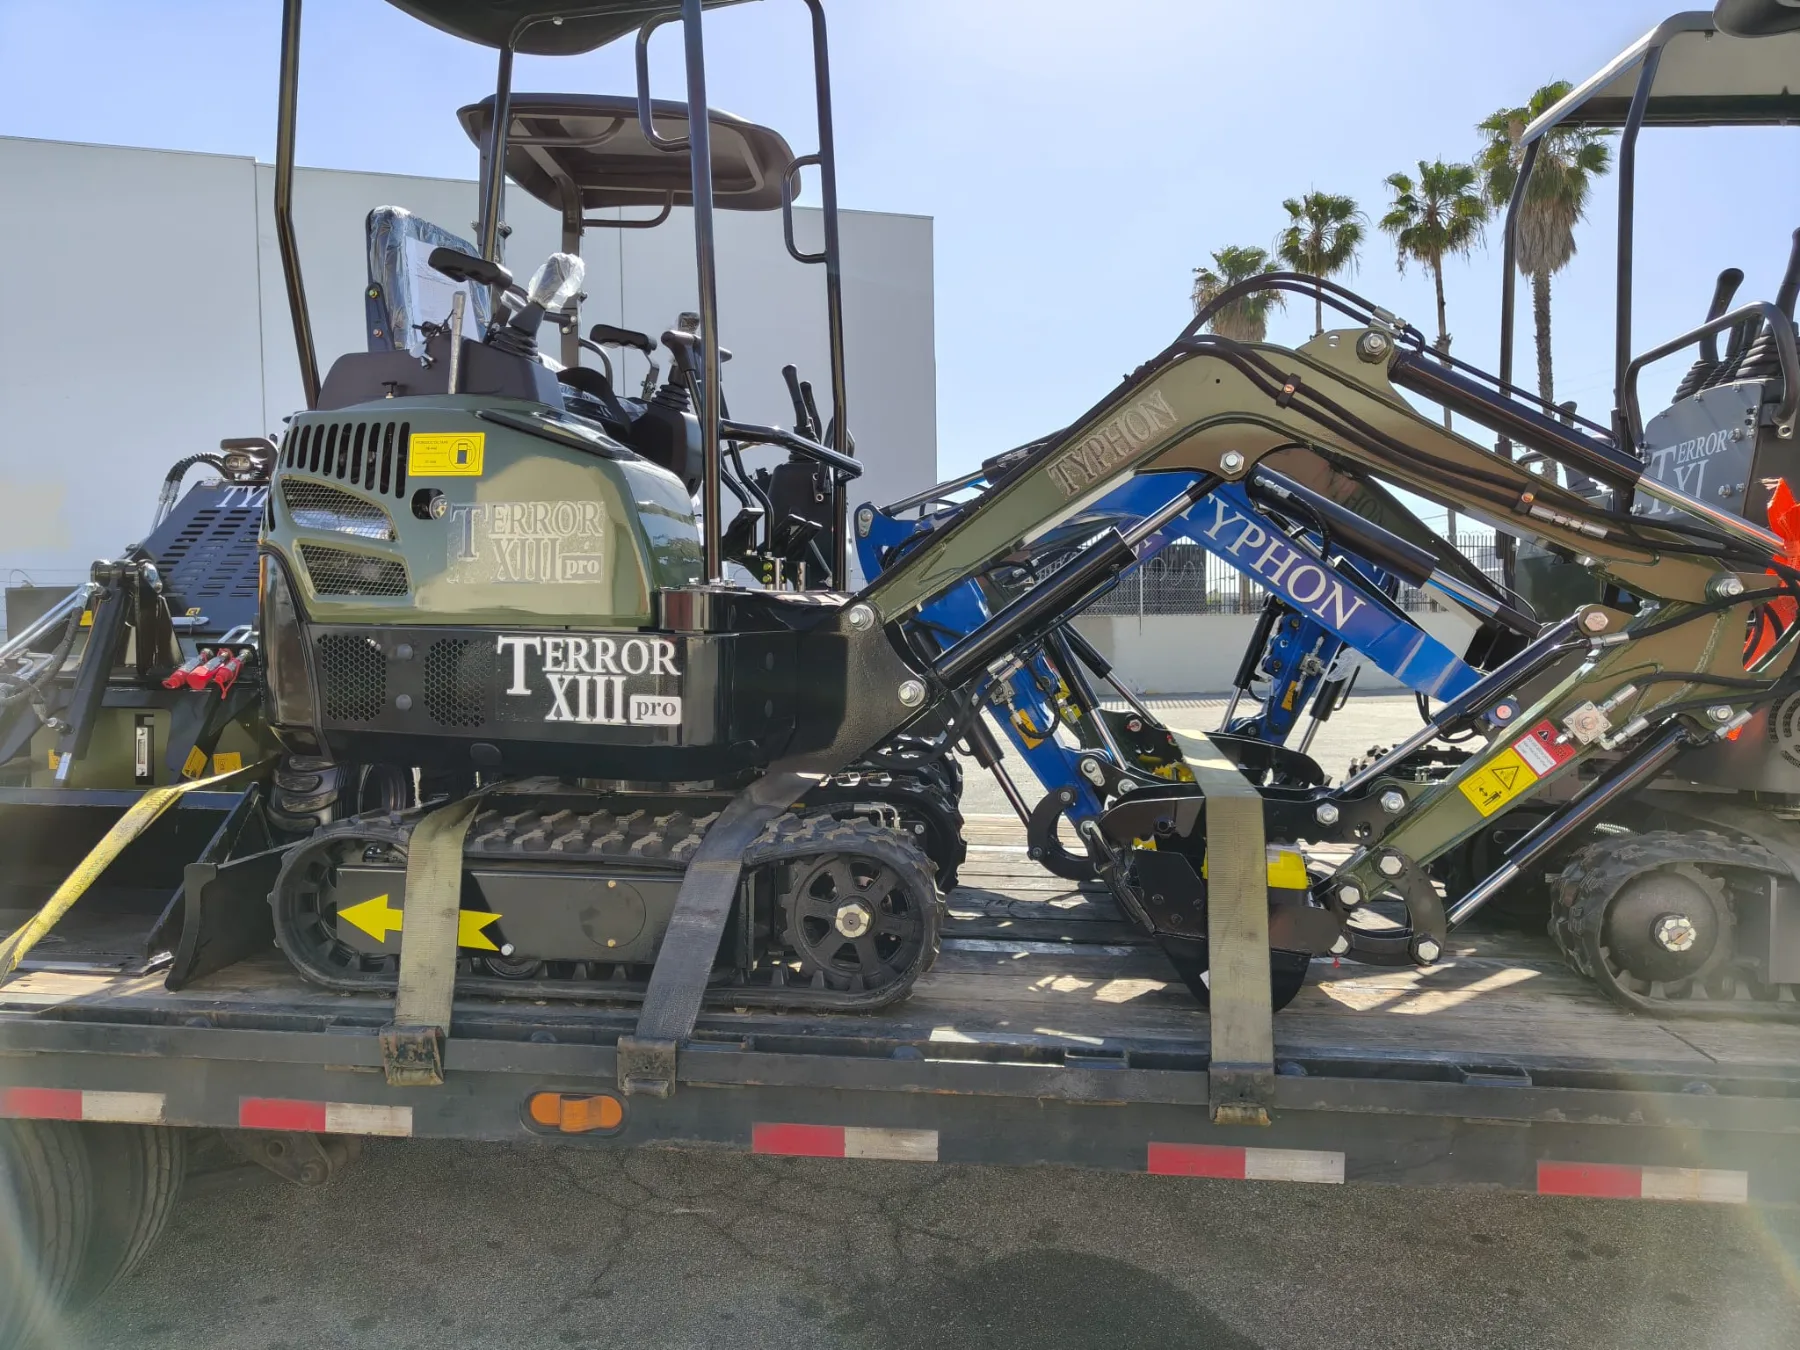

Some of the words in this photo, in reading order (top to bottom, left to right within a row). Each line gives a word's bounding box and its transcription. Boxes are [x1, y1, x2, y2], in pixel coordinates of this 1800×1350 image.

[1046, 390, 1178, 496] TYPHON
[1649, 430, 1728, 514] TERROR
[450, 501, 603, 561] TERROR
[491, 537, 561, 583] XIII
[564, 558, 600, 578] pro
[497, 635, 681, 695] TERROR
[545, 673, 627, 723] XIII
[635, 700, 677, 720] pro
